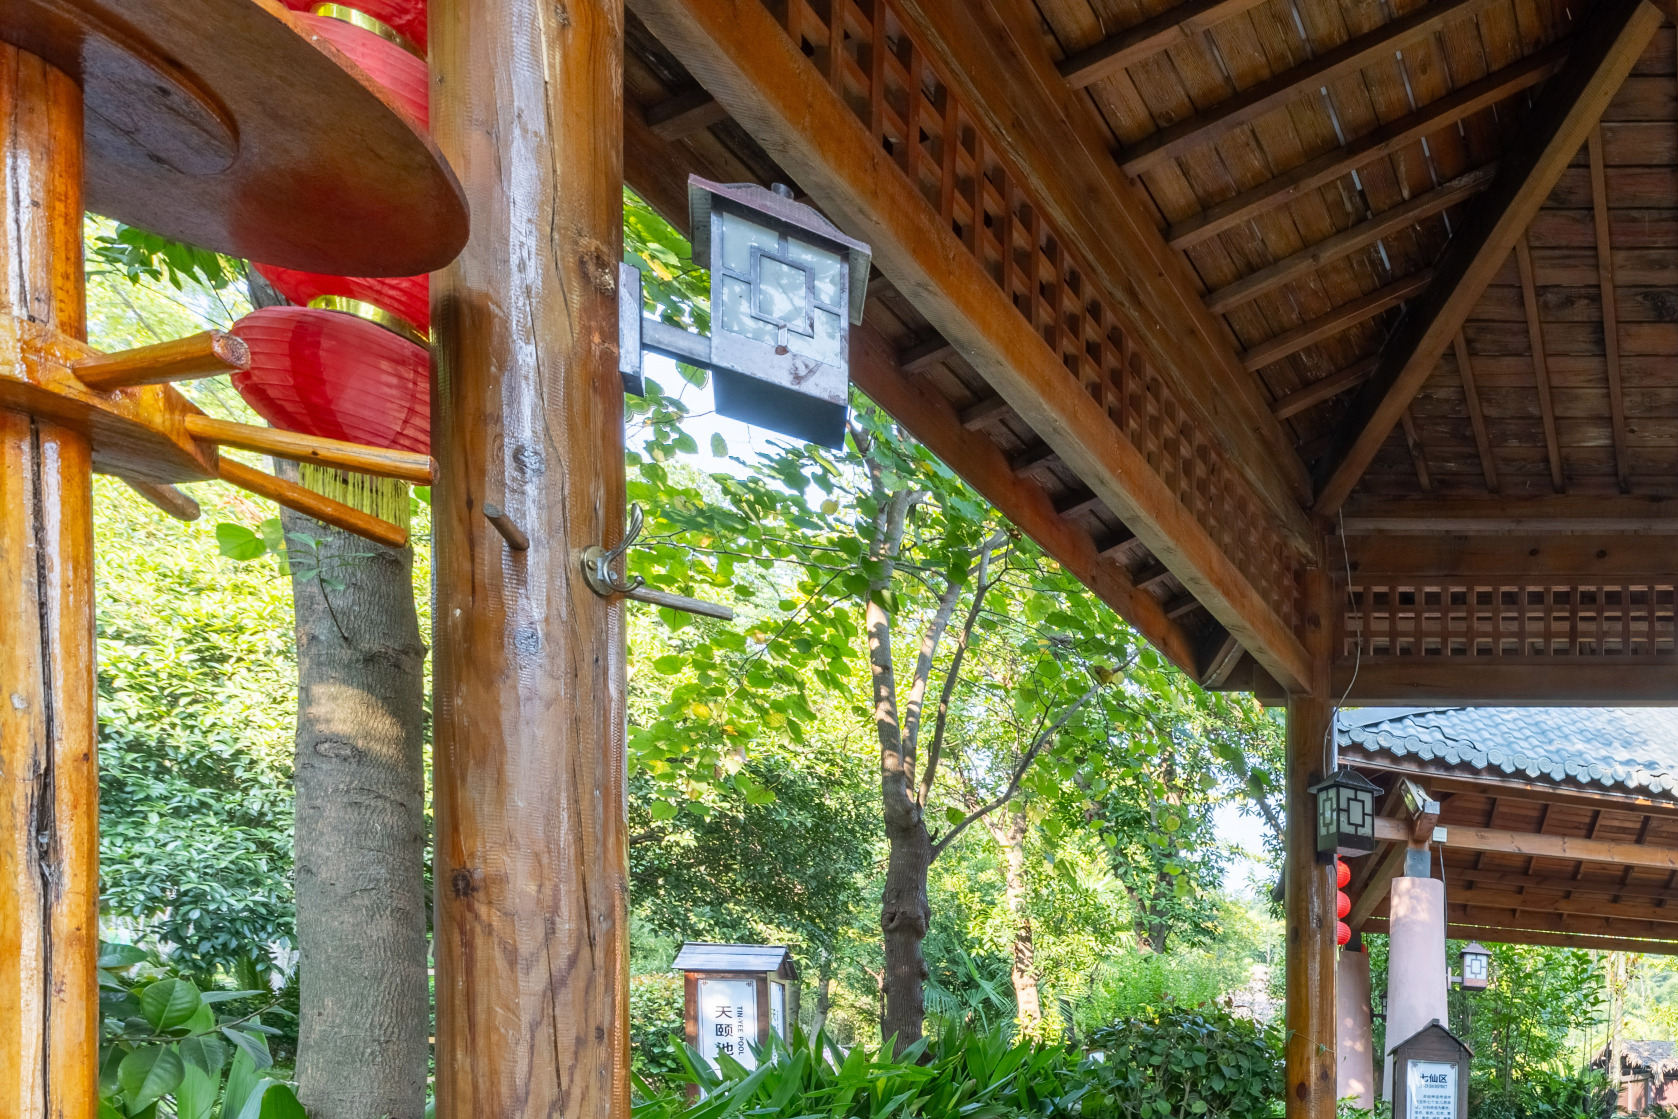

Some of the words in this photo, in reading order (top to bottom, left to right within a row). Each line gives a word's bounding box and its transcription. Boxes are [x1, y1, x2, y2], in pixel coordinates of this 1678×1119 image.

[737, 1036, 745, 1055] POOL
[1420, 1073, 1448, 1083] 七仙区
